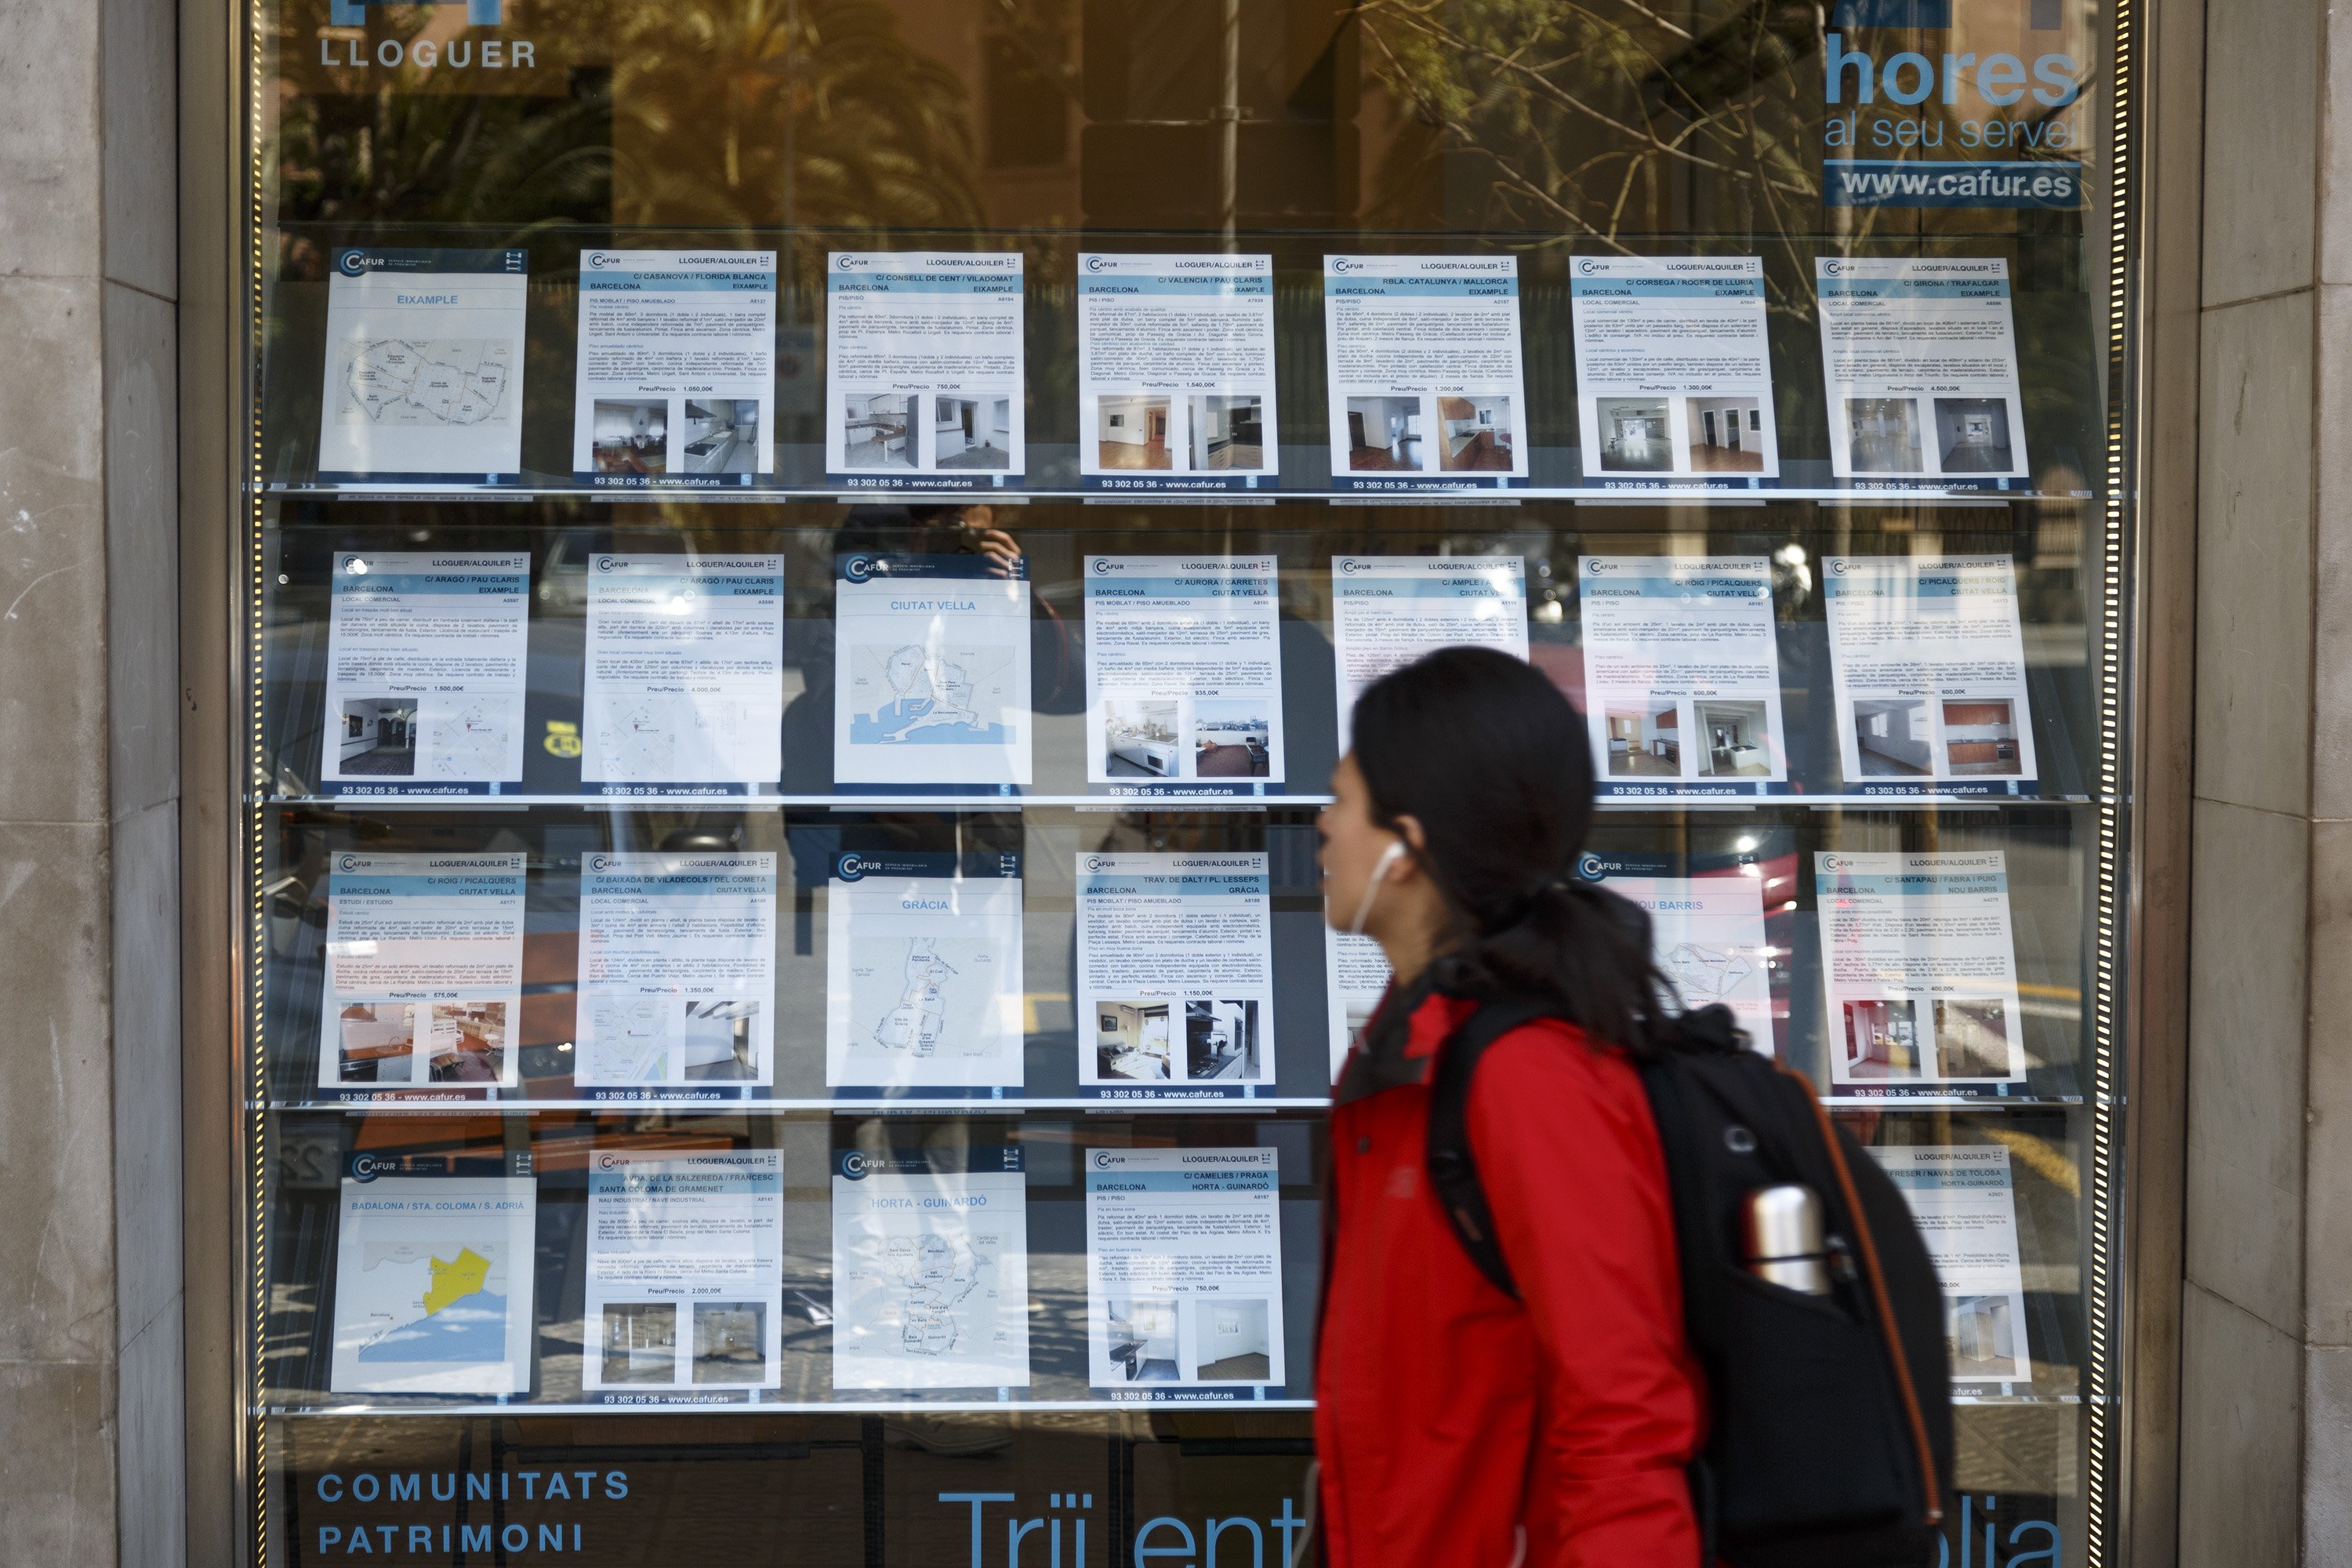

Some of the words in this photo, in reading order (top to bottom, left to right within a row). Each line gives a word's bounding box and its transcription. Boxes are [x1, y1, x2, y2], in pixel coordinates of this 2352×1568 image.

[321, 39, 535, 68] LLOGUER
[1826, 34, 2079, 107] hores
[1825, 111, 1857, 147] al
[1873, 118, 1943, 147] seu
[1960, 112, 2076, 148] servei
[1842, 169, 2071, 197] www.cafur.es
[397, 296, 458, 304] EIXAMPLE
[891, 601, 934, 610] CIUTAT
[937, 601, 975, 610] VELLA
[1229, 885, 1259, 894] GRÀCIA
[902, 898, 949, 910] GRÀCIA
[1660, 901, 1704, 910] BARRIS
[1192, 1181, 1220, 1190] HORTA
[1226, 1181, 1269, 1190] GUINARDÓ
[351, 1200, 405, 1210] BADALONA
[411, 1200, 433, 1210] STA.
[434, 1200, 477, 1210] COLOMA
[484, 1200, 492, 1210] S.
[494, 1200, 524, 1210] ADRIÀ
[872, 1194, 914, 1208] HORTA
[922, 1194, 986, 1209] GUINARDÓ
[317, 1471, 629, 1502] COMUNITATS
[318, 1524, 582, 1554] PATRIMONI
[1937, 1495, 2062, 1568] lia
